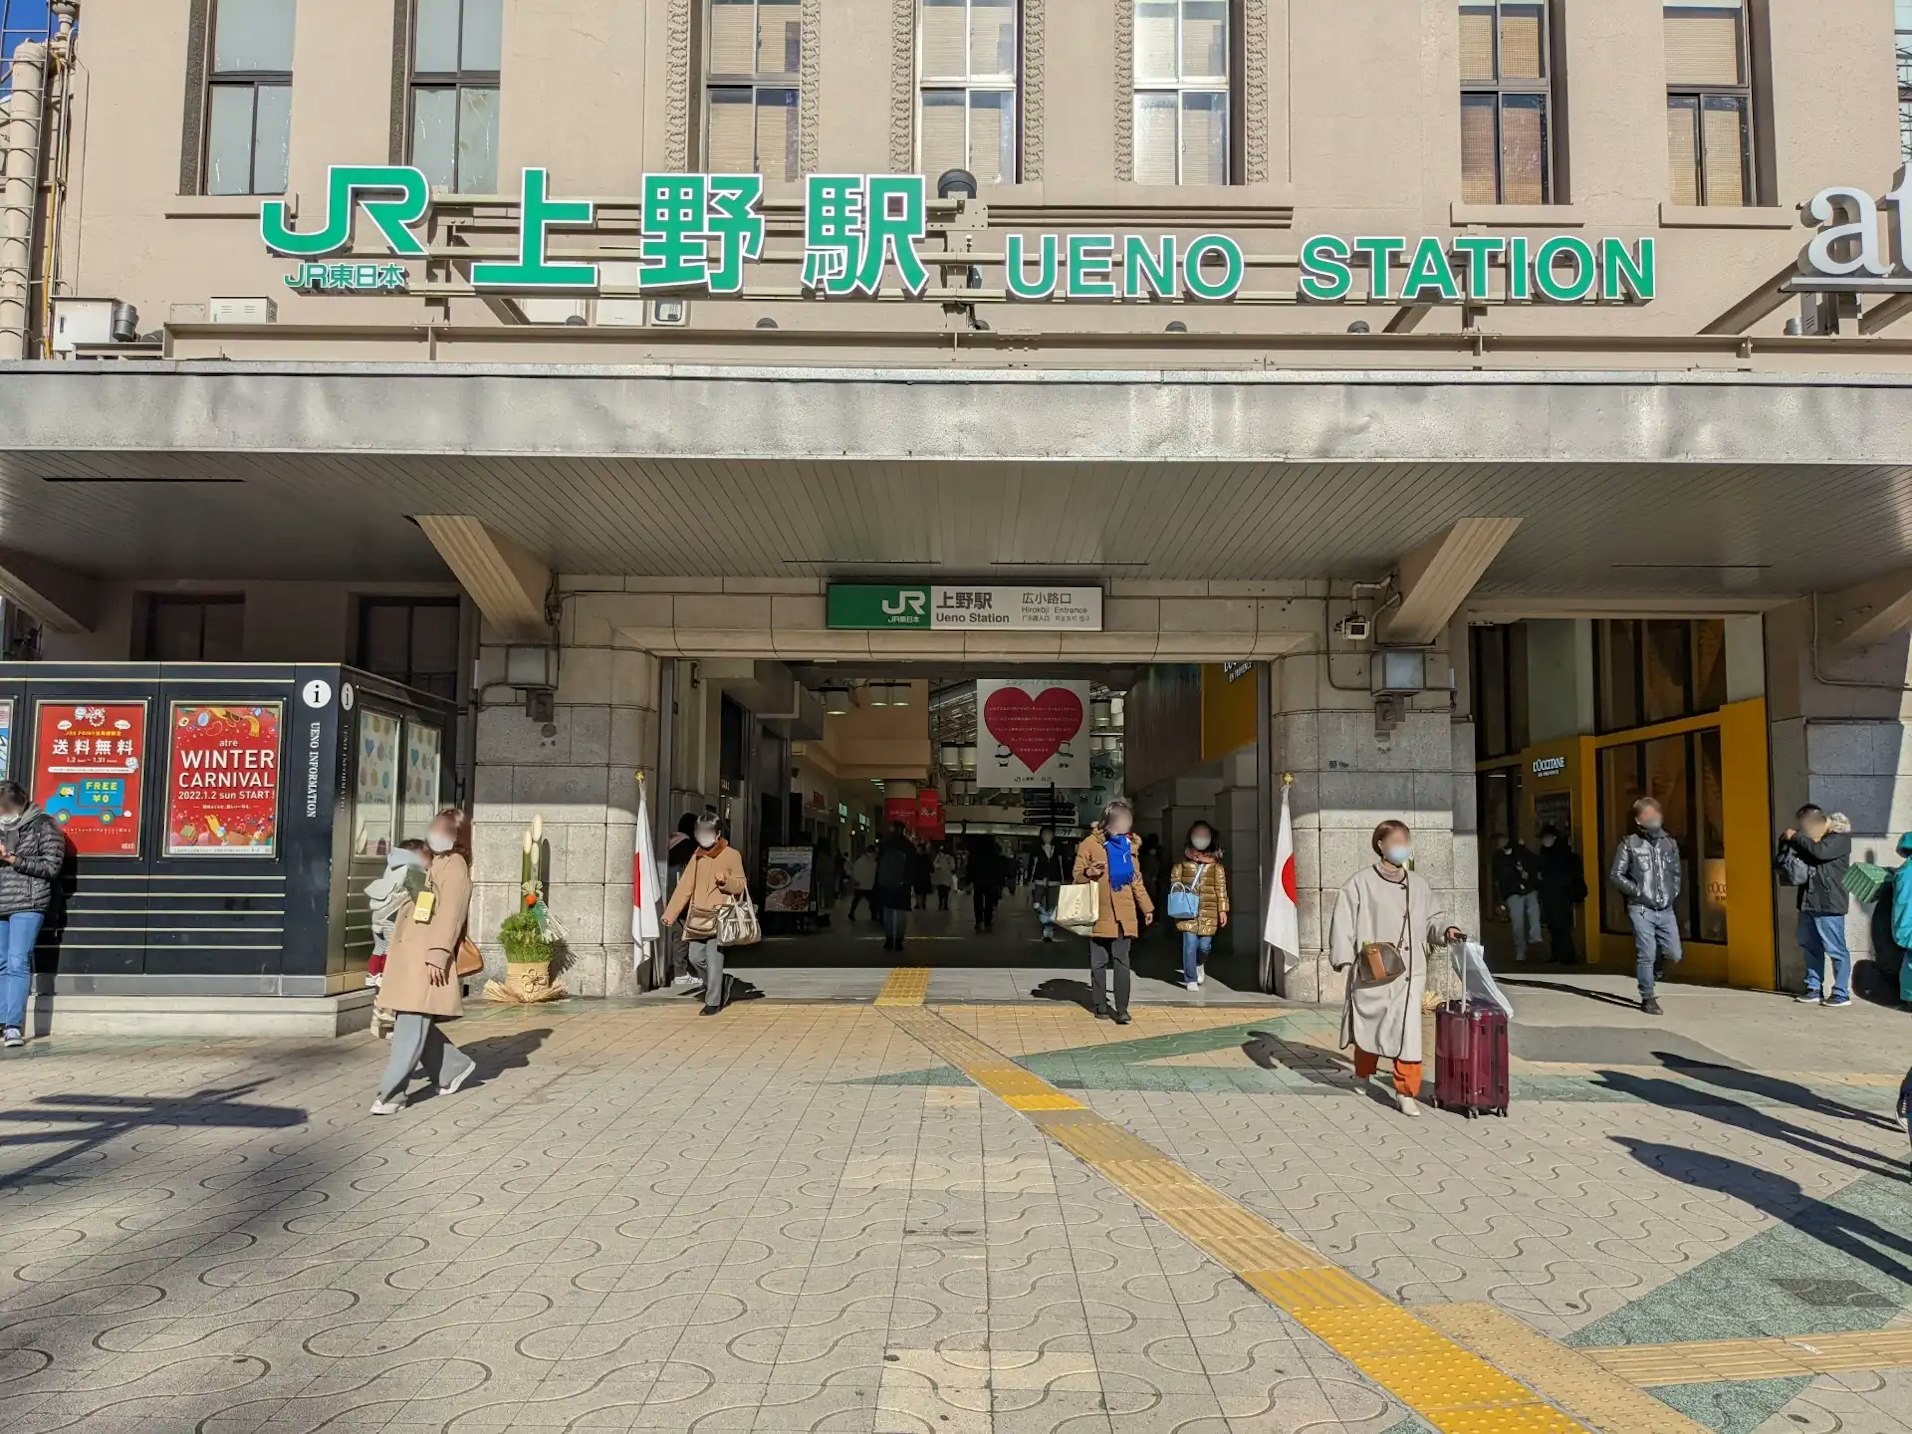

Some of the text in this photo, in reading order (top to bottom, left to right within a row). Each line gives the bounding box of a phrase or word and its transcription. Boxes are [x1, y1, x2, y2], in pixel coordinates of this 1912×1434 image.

[260, 165, 430, 255] JR
[470, 167, 930, 296] 上野駅
[284, 263, 405, 289] JR東日本
[1006, 233, 1656, 302] UENO STATION
[881, 590, 926, 615] JR
[935, 591, 993, 610] 上野駅
[1022, 592, 1072, 604] 広小路口
[936, 612, 1010, 624] Ueno Station
[1054, 606, 1088, 614] Entrance
[52, 739, 133, 756] 送料無料
[181, 749, 275, 769] WINTER
[306, 722, 321, 818] UENO INFORMATION
[85, 781, 118, 791] FREE
[179, 772, 275, 788] CARNIVAL
[178, 791, 217, 800] 2022.1.2
[219, 792, 237, 800] sun
